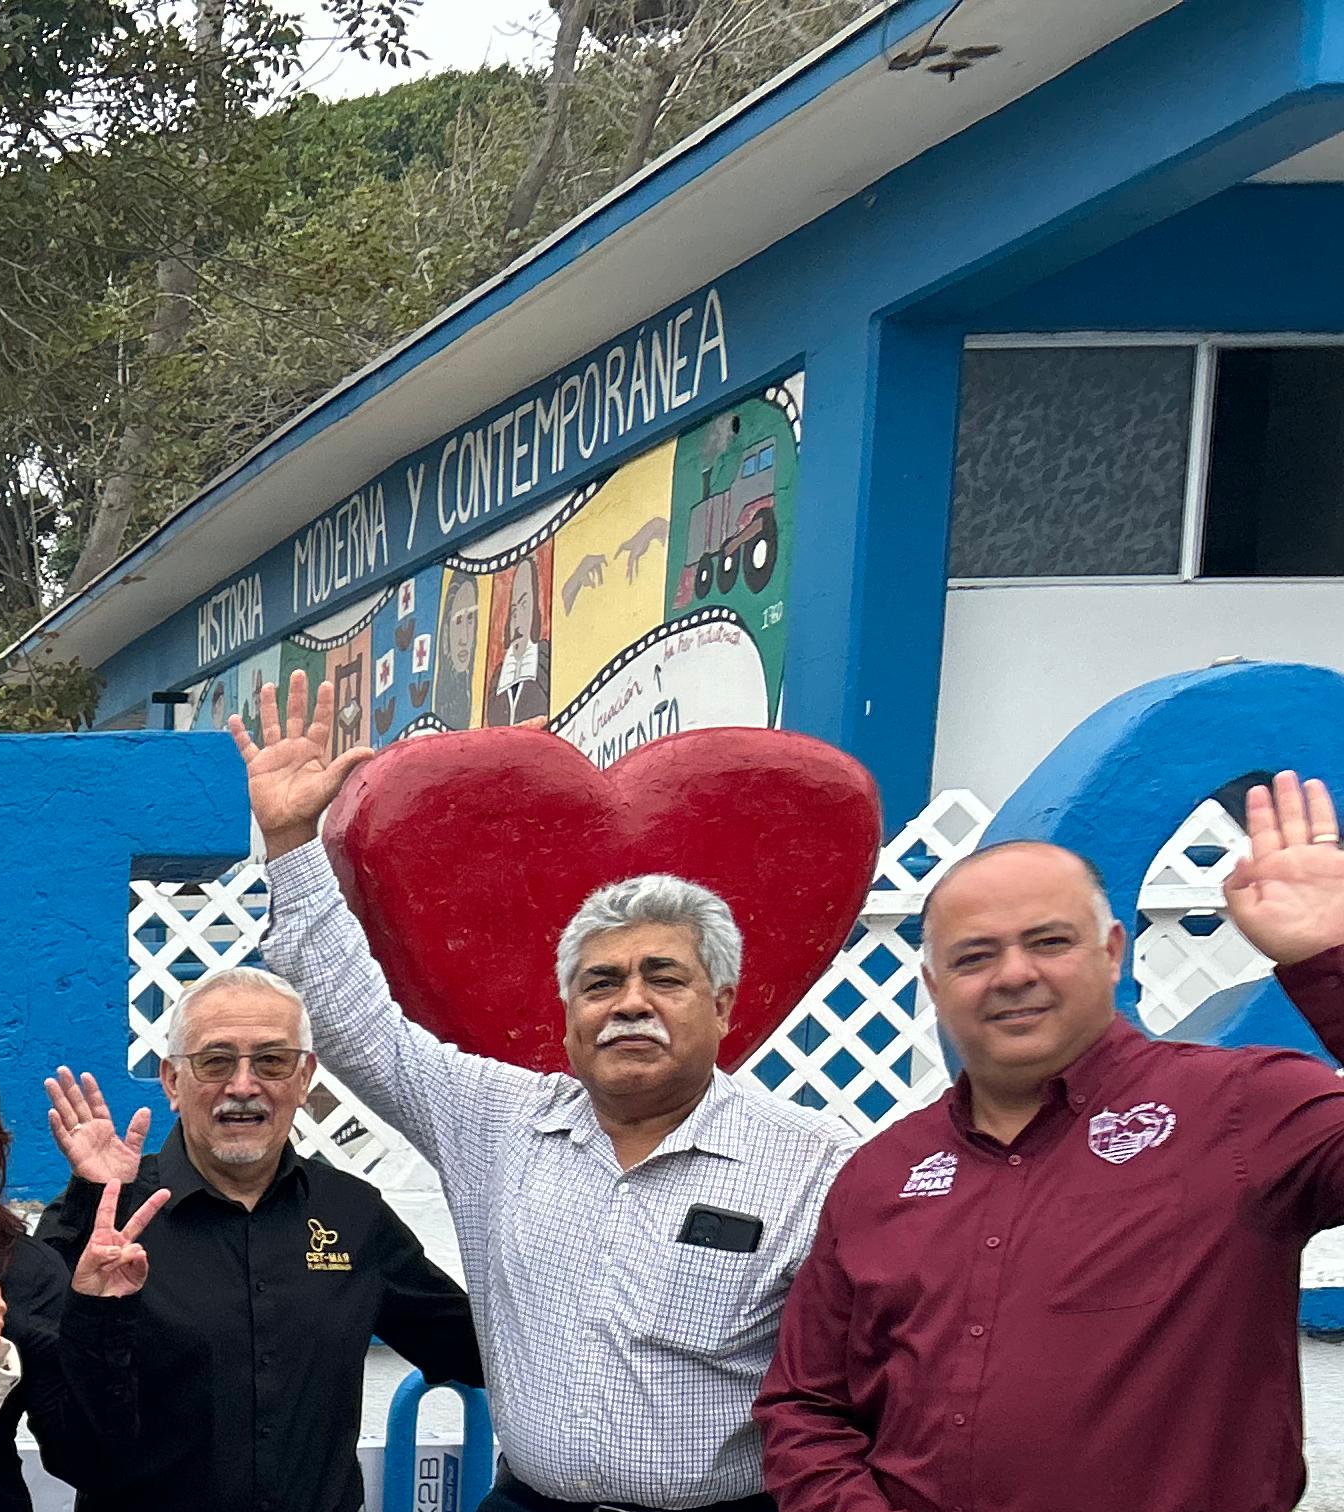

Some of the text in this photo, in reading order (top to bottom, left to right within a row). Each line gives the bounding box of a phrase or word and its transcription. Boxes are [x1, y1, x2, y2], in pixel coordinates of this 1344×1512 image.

[198, 288, 729, 667] HISTORIA MODERNA Y CONTEMPORÁNEA
